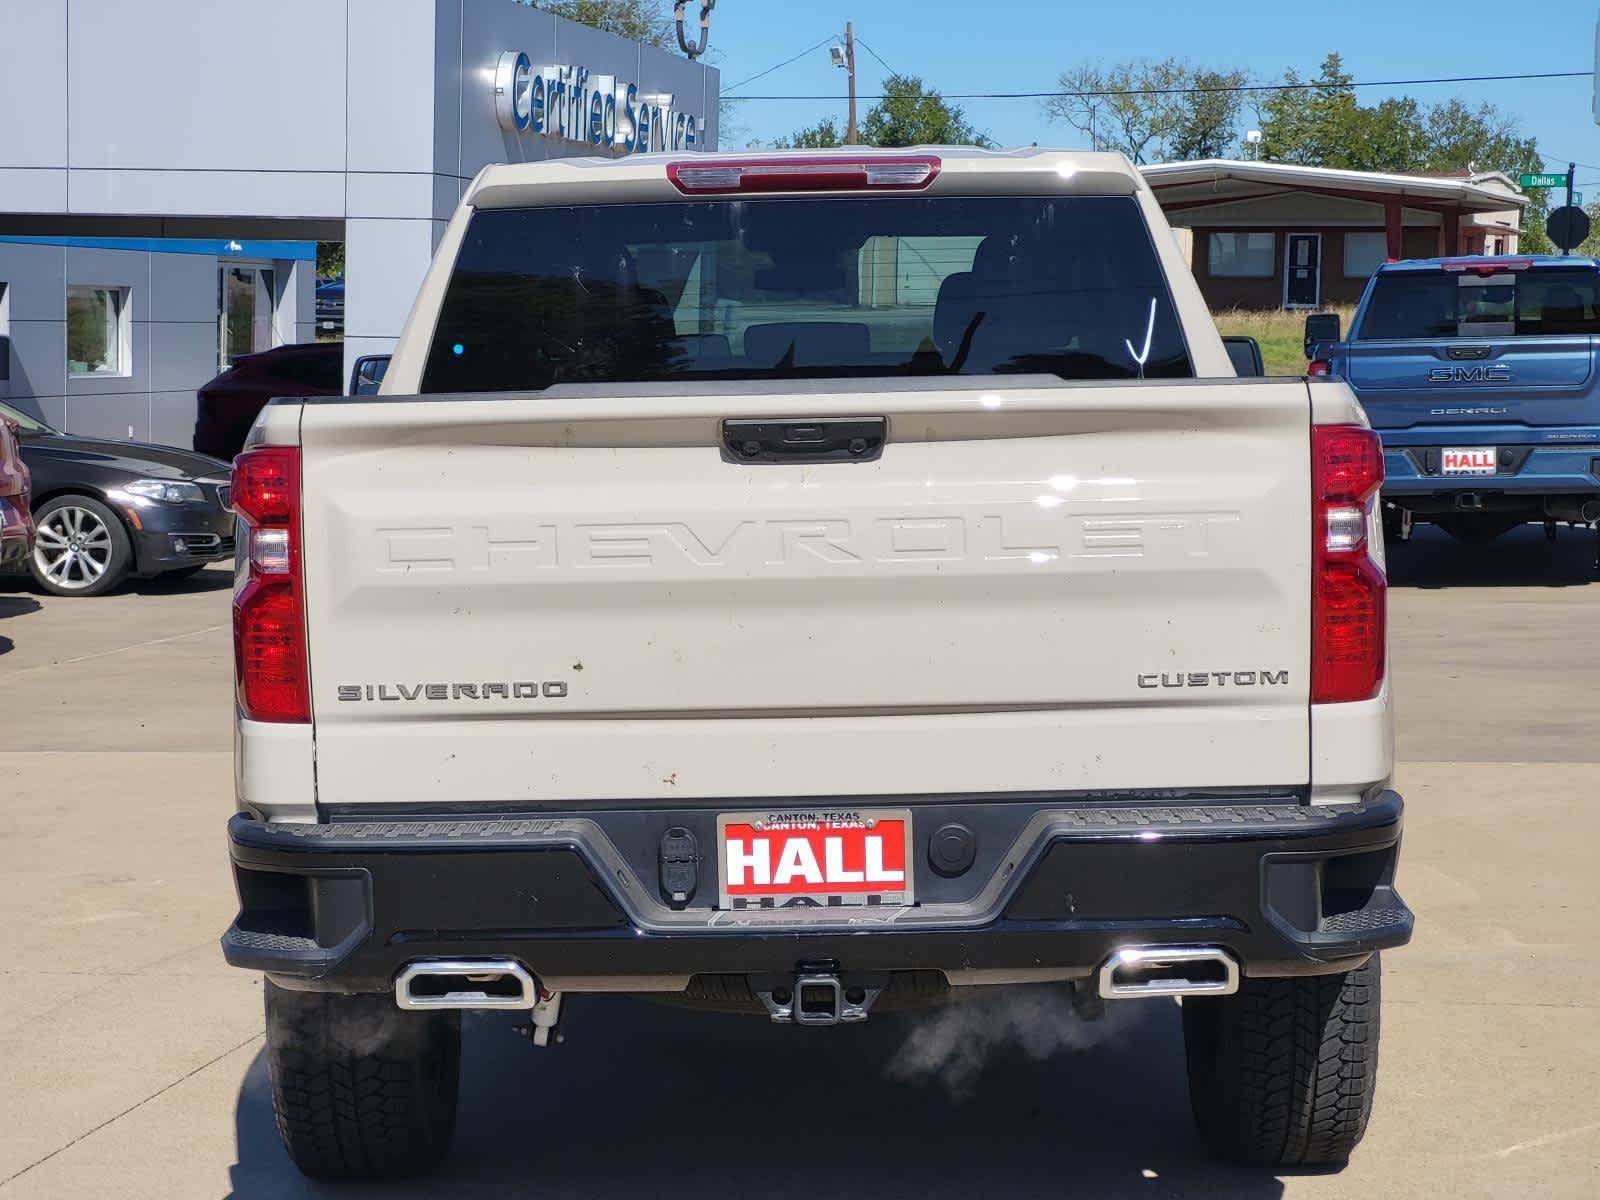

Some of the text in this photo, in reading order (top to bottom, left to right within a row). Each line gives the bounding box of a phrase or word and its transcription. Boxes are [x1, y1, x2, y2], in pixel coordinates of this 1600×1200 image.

[503, 51, 697, 153] Certified Service
[1531, 176, 1555, 185] Dallas
[1428, 366, 1511, 382] GMC
[1431, 407, 1507, 415] DENALI
[1444, 454, 1494, 468] HALL
[376, 511, 1241, 572] CHEVROLET
[1137, 670, 1289, 688] CUSTOM
[337, 681, 568, 701] SILVERADO
[768, 812, 860, 823] CANTON, TEXAS
[726, 836, 905, 885] HALL
